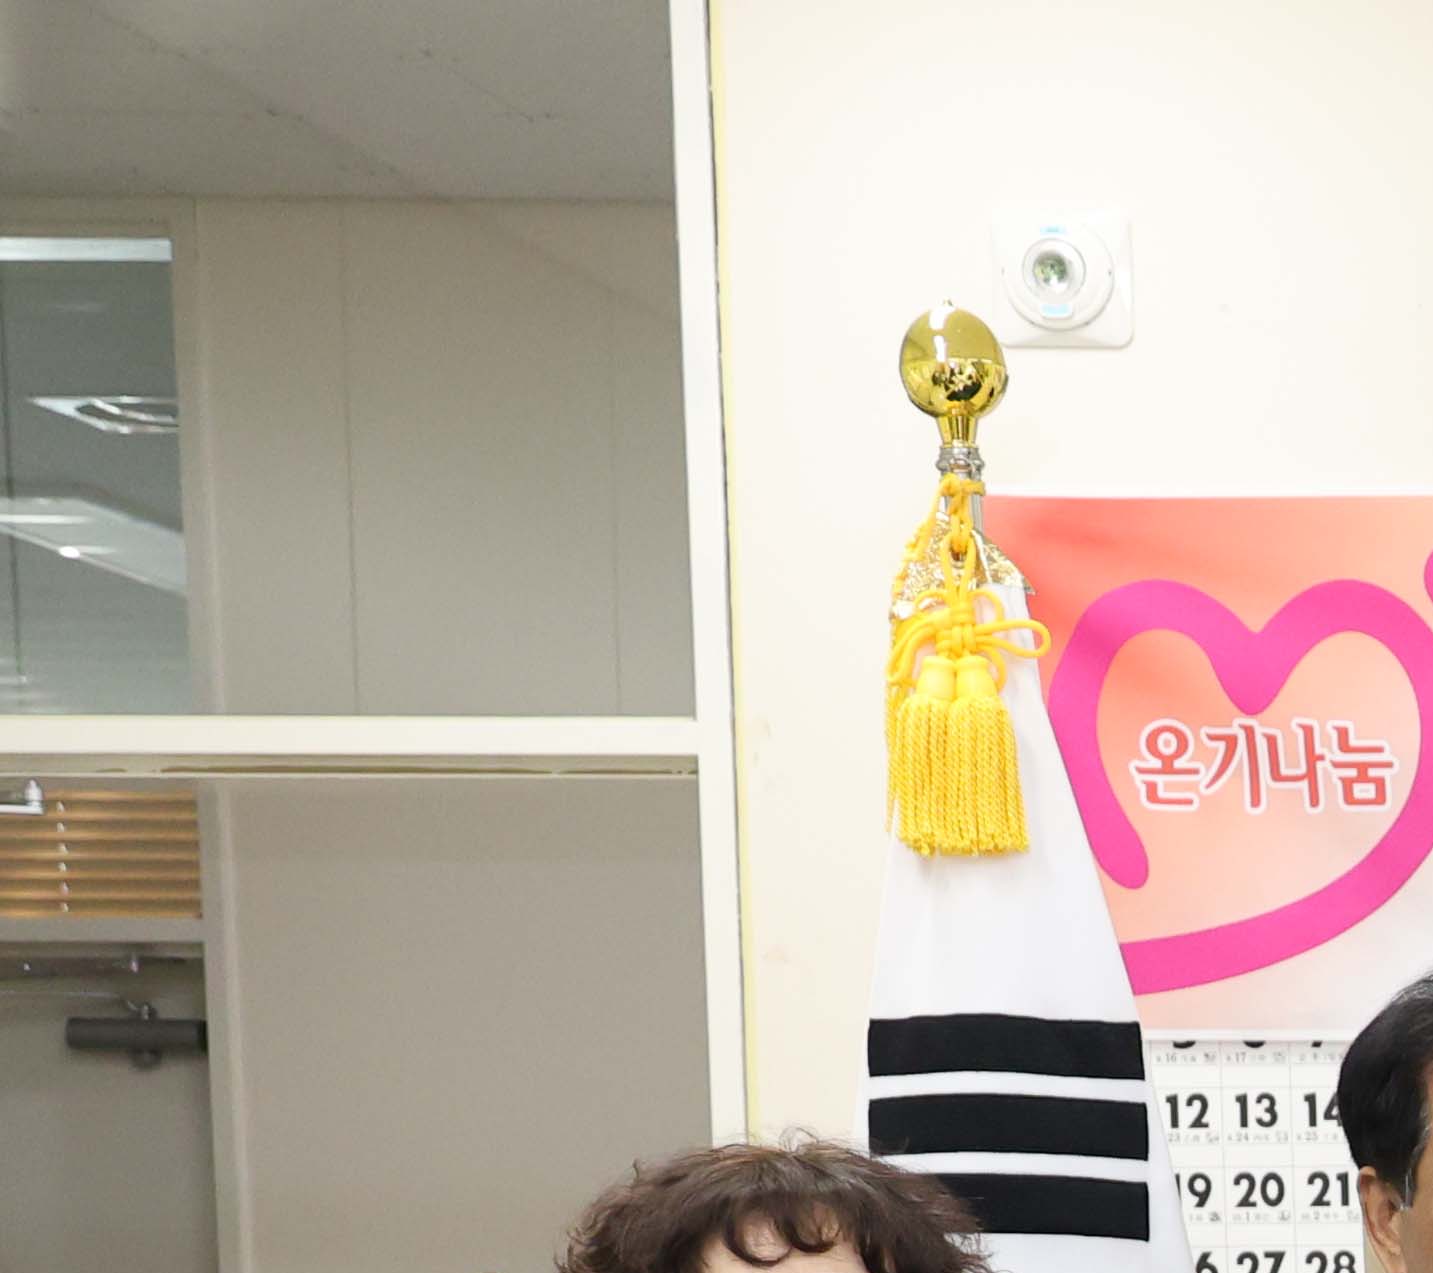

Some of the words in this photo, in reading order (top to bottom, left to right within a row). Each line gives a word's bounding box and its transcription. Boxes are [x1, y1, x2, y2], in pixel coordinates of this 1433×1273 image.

[1134, 716, 1394, 811] 온기나눔
[1165, 1093, 1210, 1128] 12
[1235, 1093, 1278, 1128] 13
[1304, 1092, 1343, 1127] 14
[1233, 1171, 1285, 1207] 20
[1307, 1171, 1350, 1206] 21
